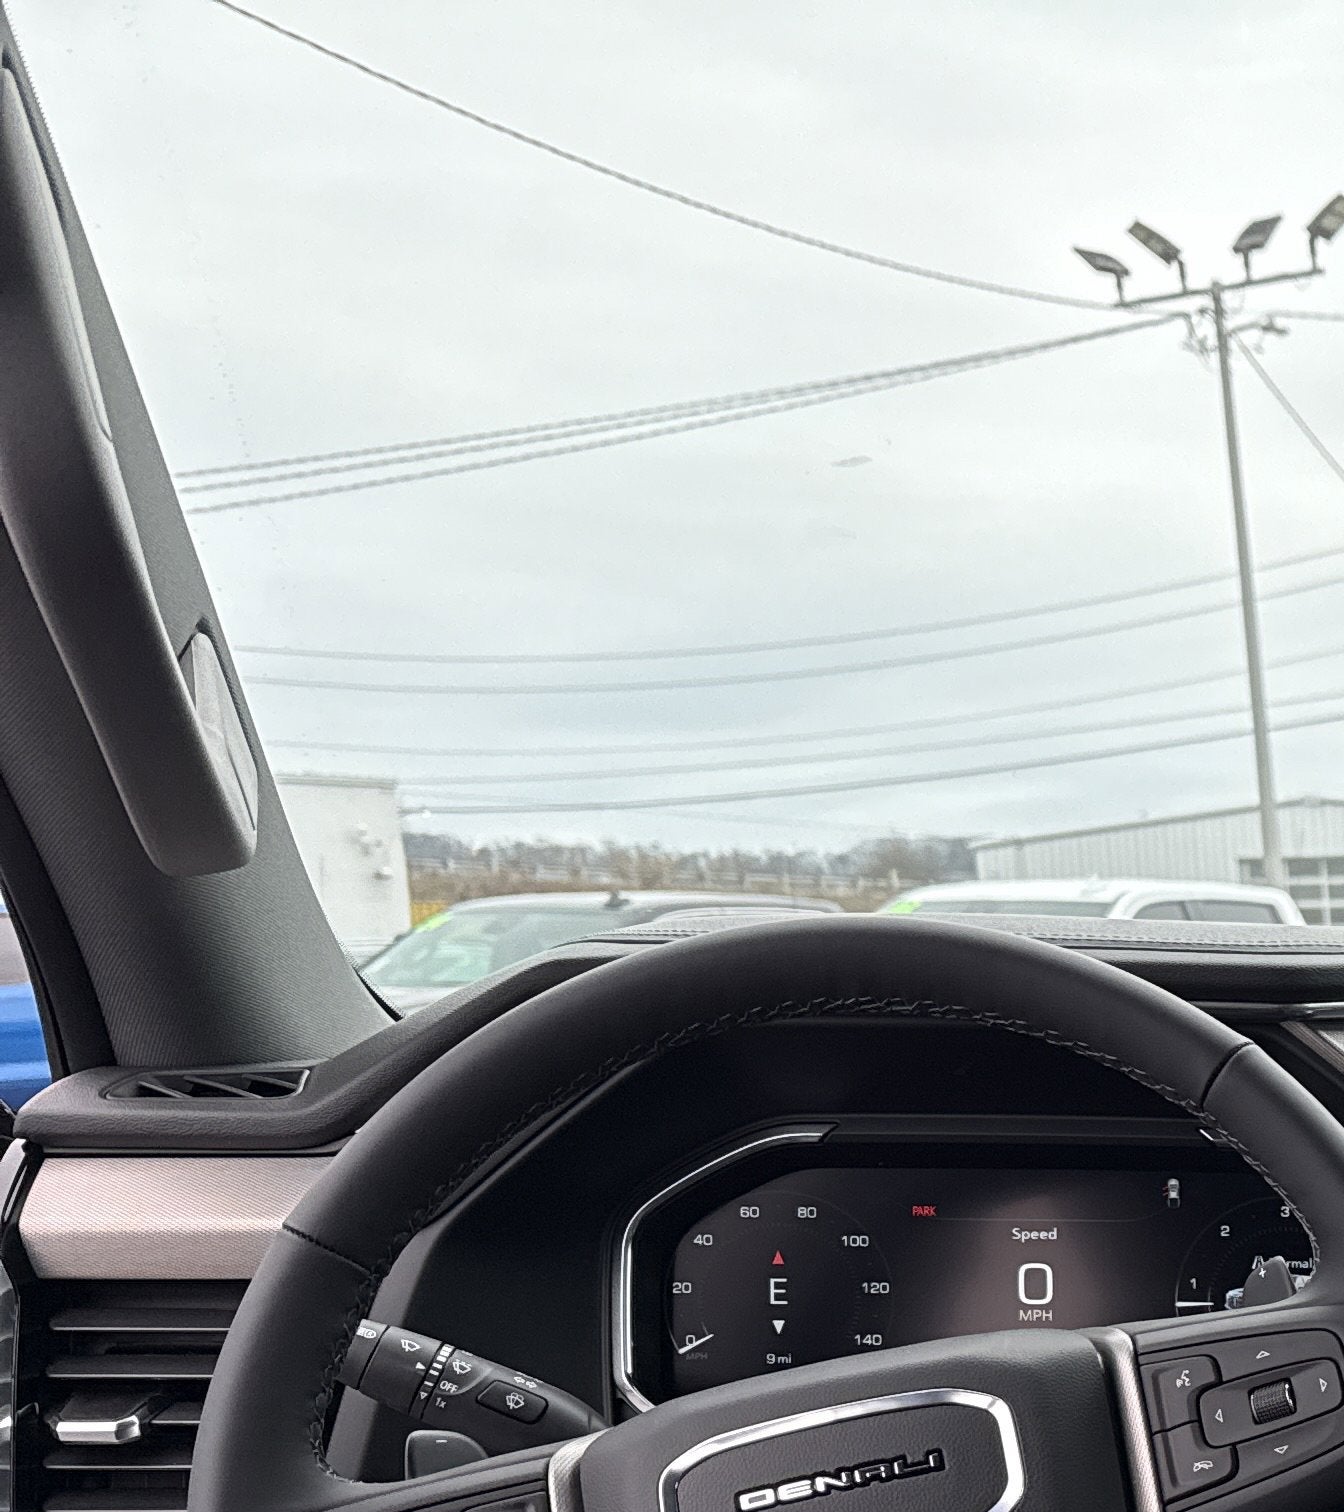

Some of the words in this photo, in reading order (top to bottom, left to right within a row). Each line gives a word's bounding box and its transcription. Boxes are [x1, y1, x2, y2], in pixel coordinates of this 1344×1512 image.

[740, 1206, 760, 1218] 60
[797, 1206, 817, 1219] 80
[912, 1205, 937, 1217] PARK
[1280, 1206, 1290, 1218] 3
[1011, 1227, 1058, 1243] Speed
[1219, 1225, 1231, 1237] 2
[693, 1234, 713, 1246] 40
[841, 1235, 869, 1247] 100
[672, 1282, 692, 1294] 20
[861, 1282, 890, 1294] 120
[1017, 1262, 1054, 1305] 0
[1189, 1277, 1197, 1290] 1
[769, 1277, 788, 1305] E
[1018, 1309, 1053, 1322] MPH
[685, 1334, 696, 1347] 0
[854, 1334, 883, 1346] 140
[766, 1353, 776, 1364] 9
[777, 1353, 792, 1364] mi
[439, 1380, 458, 1393] OFF
[738, 1452, 943, 1511] DENALI
